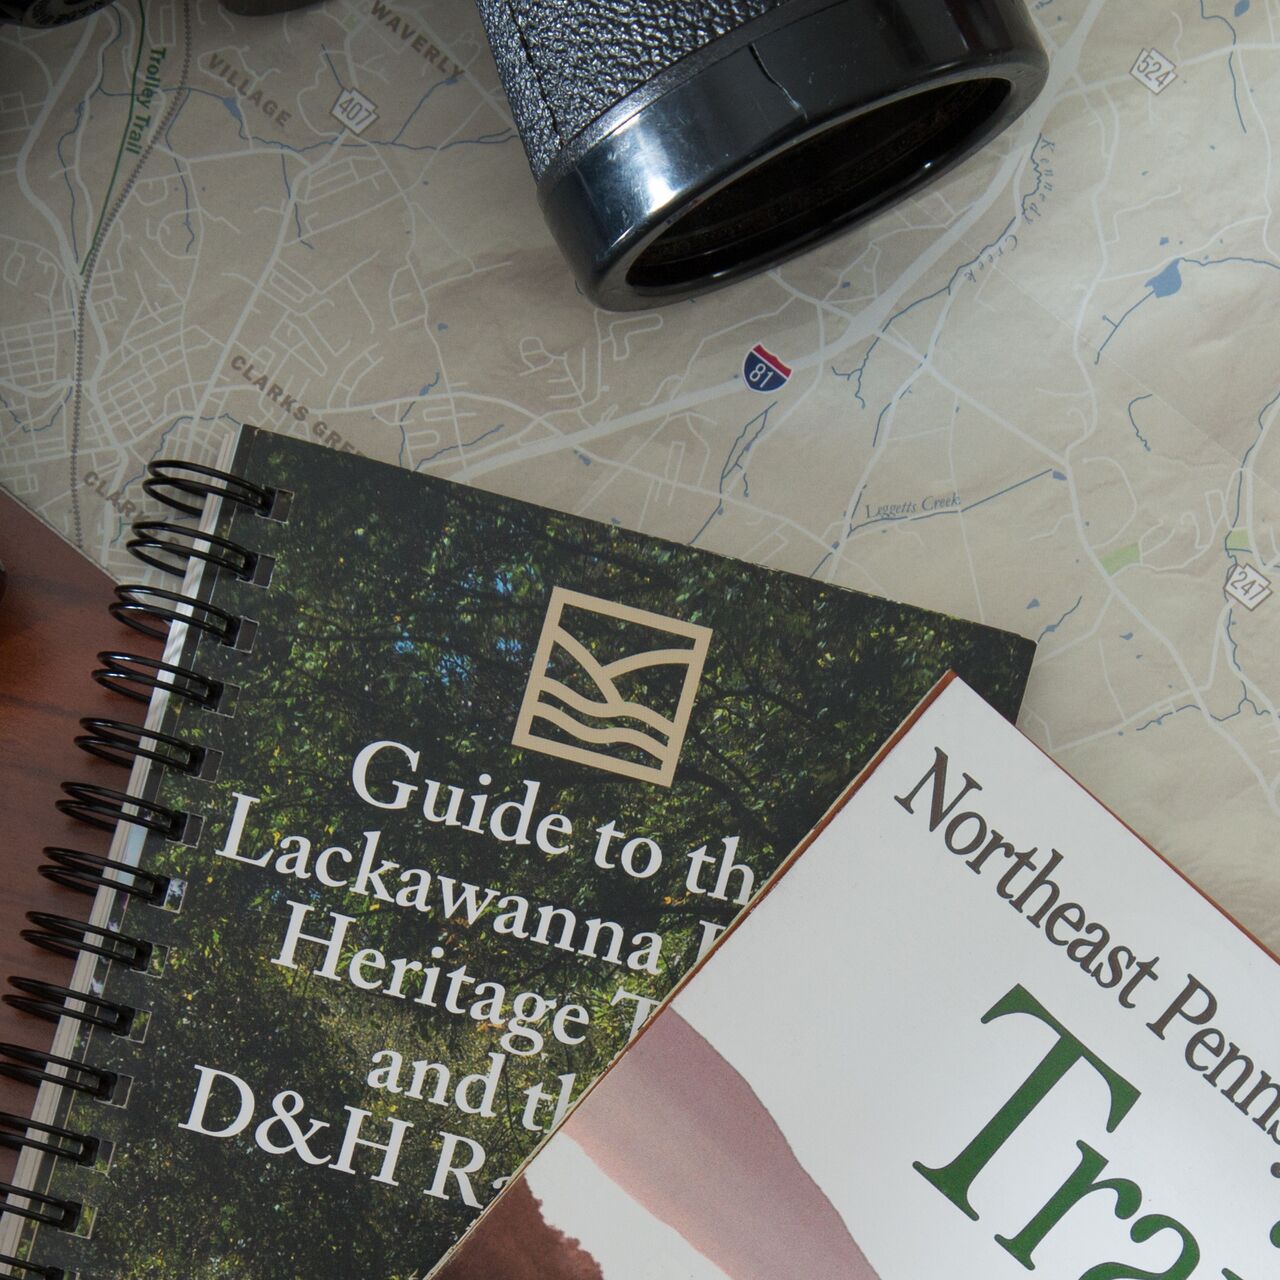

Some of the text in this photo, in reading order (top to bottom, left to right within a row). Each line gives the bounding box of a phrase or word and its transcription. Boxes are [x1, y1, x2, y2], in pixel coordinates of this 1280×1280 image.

[370, 2, 465, 80] WAVERLY
[1136, 54, 1172, 88] 524
[125, 46, 167, 155] Trolley Trail
[207, 52, 292, 128] VILLAGE
[337, 96, 374, 127] 407
[230, 354, 310, 422] CLARKS
[749, 362, 774, 389] 81
[921, 491, 962, 512] Creek
[1229, 570, 1266, 598] 247
[351, 738, 663, 879] Guide to
[215, 792, 661, 975] Lackawanna
[894, 746, 1160, 1009] Northeast
[271, 900, 590, 1057] Heritage
[367, 1052, 504, 1120] and
[178, 1063, 416, 1187] D&H
